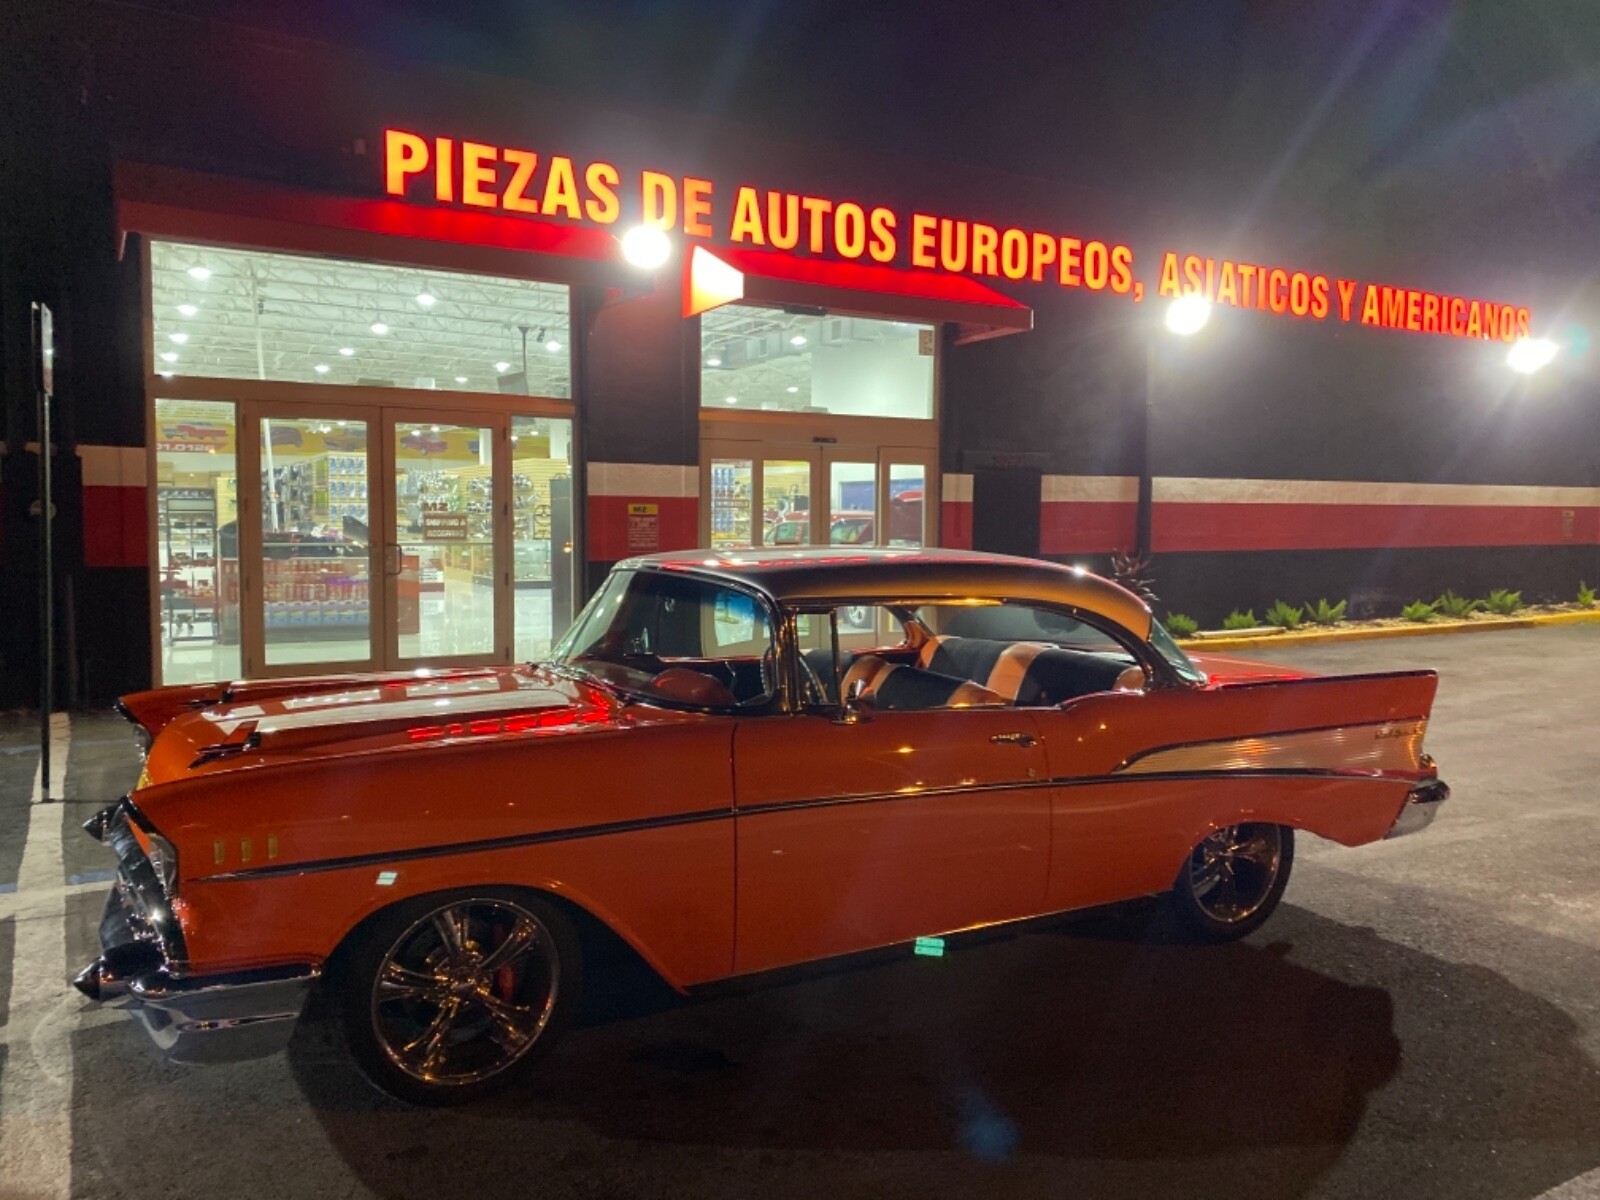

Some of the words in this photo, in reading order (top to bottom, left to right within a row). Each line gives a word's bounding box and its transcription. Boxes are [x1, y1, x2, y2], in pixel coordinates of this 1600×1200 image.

[385, 129, 620, 225] PIEZAS
[642, 169, 713, 238] DE
[729, 186, 898, 264] AUTOS
[911, 213, 1144, 303] EUROPEOS,
[1158, 251, 1331, 319] ASIATICOS
[1336, 279, 1357, 322] Y
[1360, 284, 1531, 342] AMERICANOS
